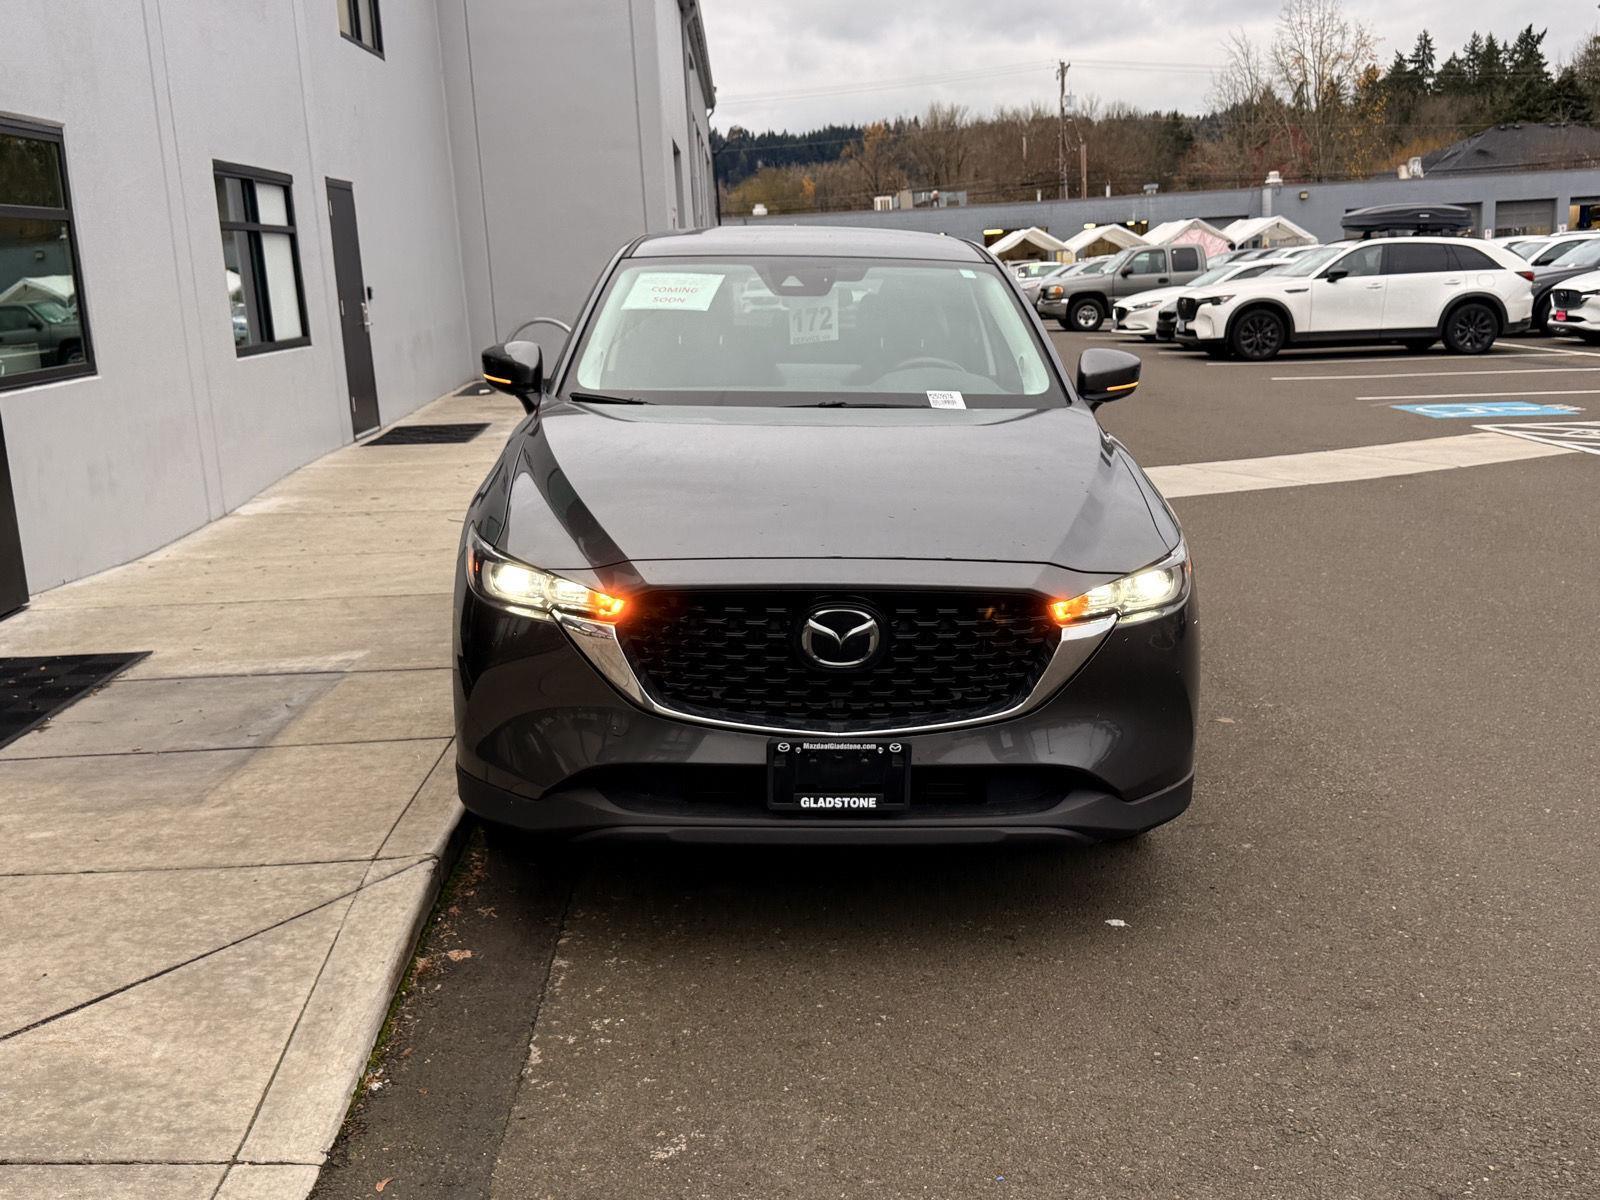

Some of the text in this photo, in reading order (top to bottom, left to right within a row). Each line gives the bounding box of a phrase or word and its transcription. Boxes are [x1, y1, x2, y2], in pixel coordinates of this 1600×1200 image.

[651, 286, 699, 294] COMING
[652, 296, 687, 304] SOON
[792, 306, 833, 333] 172
[800, 797, 877, 808] GLADSTONE
